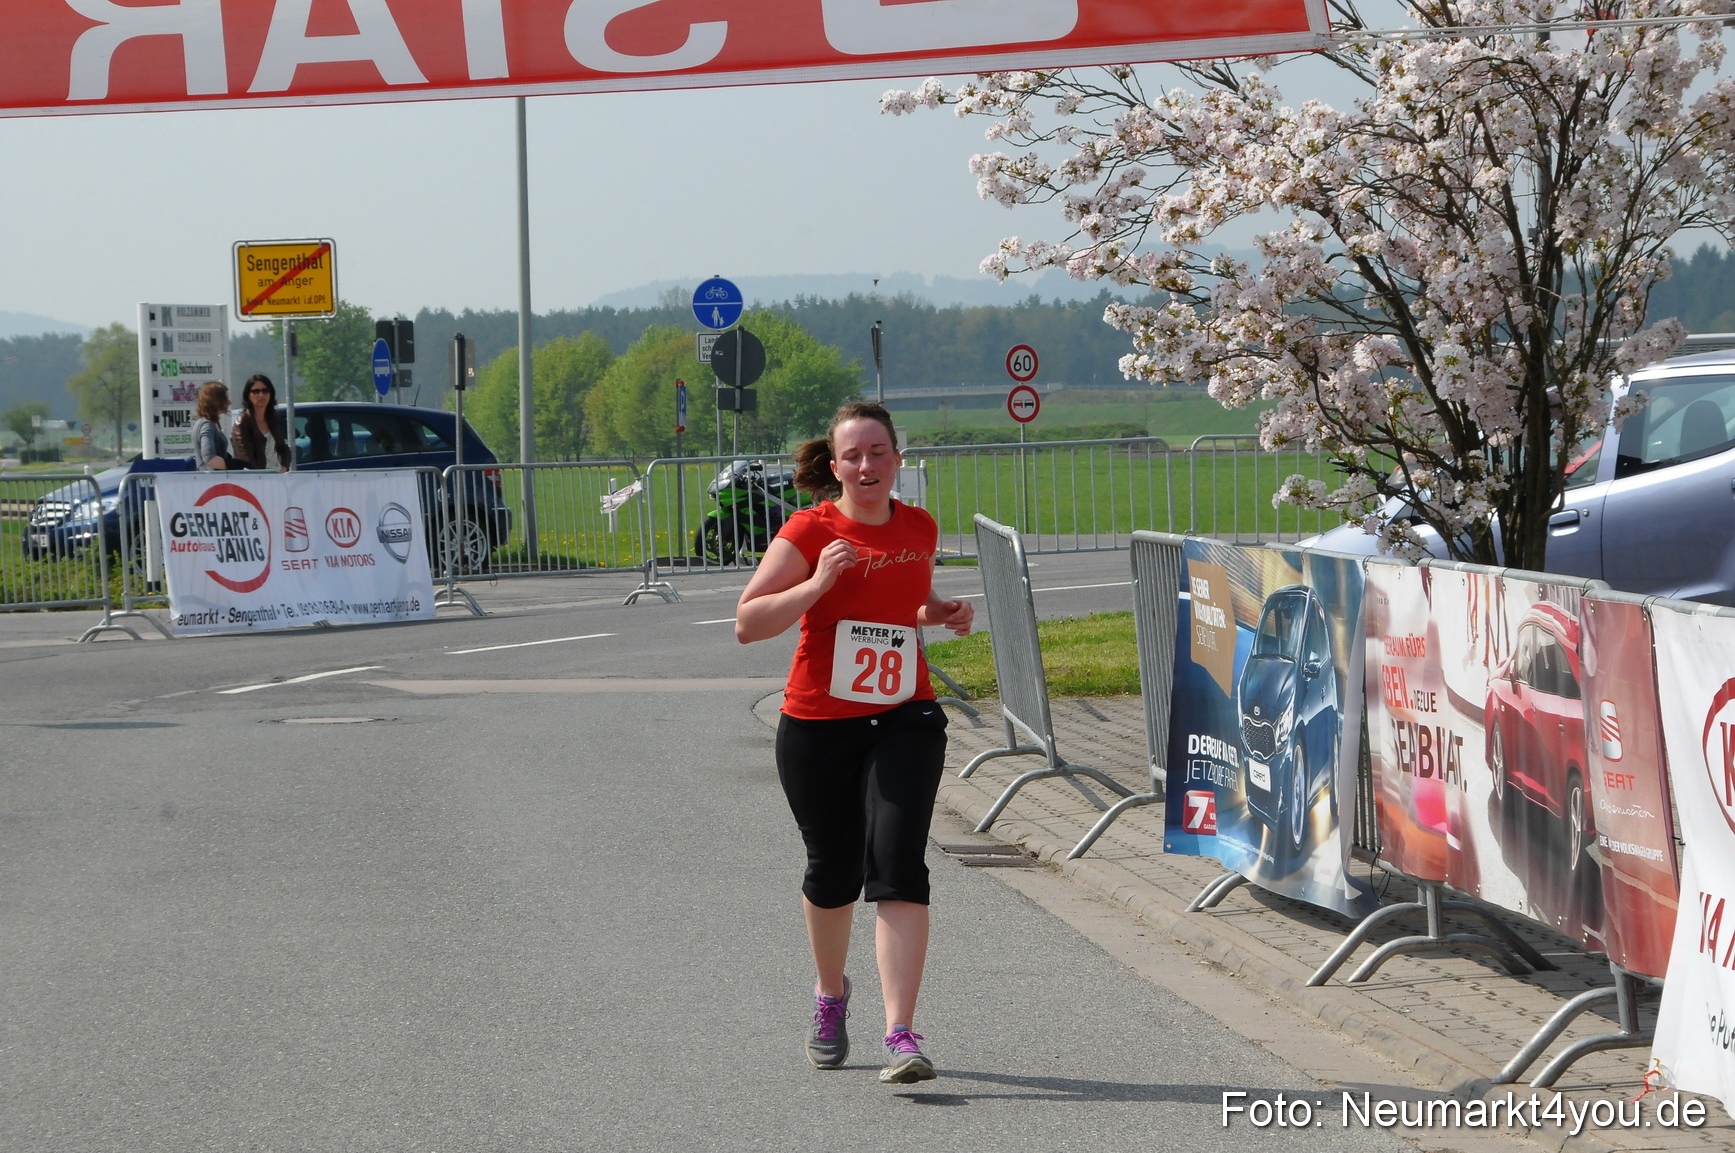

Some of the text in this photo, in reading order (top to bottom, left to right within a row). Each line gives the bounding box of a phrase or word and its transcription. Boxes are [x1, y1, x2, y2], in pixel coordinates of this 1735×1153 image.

[247, 253, 323, 275] Sengenthal
[258, 276, 313, 288] am Anger
[267, 296, 300, 305] Neumarkt
[1013, 355, 1032, 372] 60
[162, 410, 191, 428] THULE
[170, 512, 259, 538] GERHART &
[331, 518, 356, 539] KIA
[381, 527, 411, 540] NISSA
[170, 539, 216, 553] Autohaus
[216, 537, 266, 564] JÄNIG
[281, 558, 318, 571] SEAT
[325, 553, 375, 568] KIA MOTORS
[177, 608, 219, 626] eumarkt
[228, 604, 276, 627] Sengenthal
[850, 635, 890, 646] WERBUNG
[851, 625, 890, 639] MEYER
[1405, 632, 1427, 659] FÜRS
[851, 647, 903, 696] 28
[1187, 796, 1209, 829] 7
